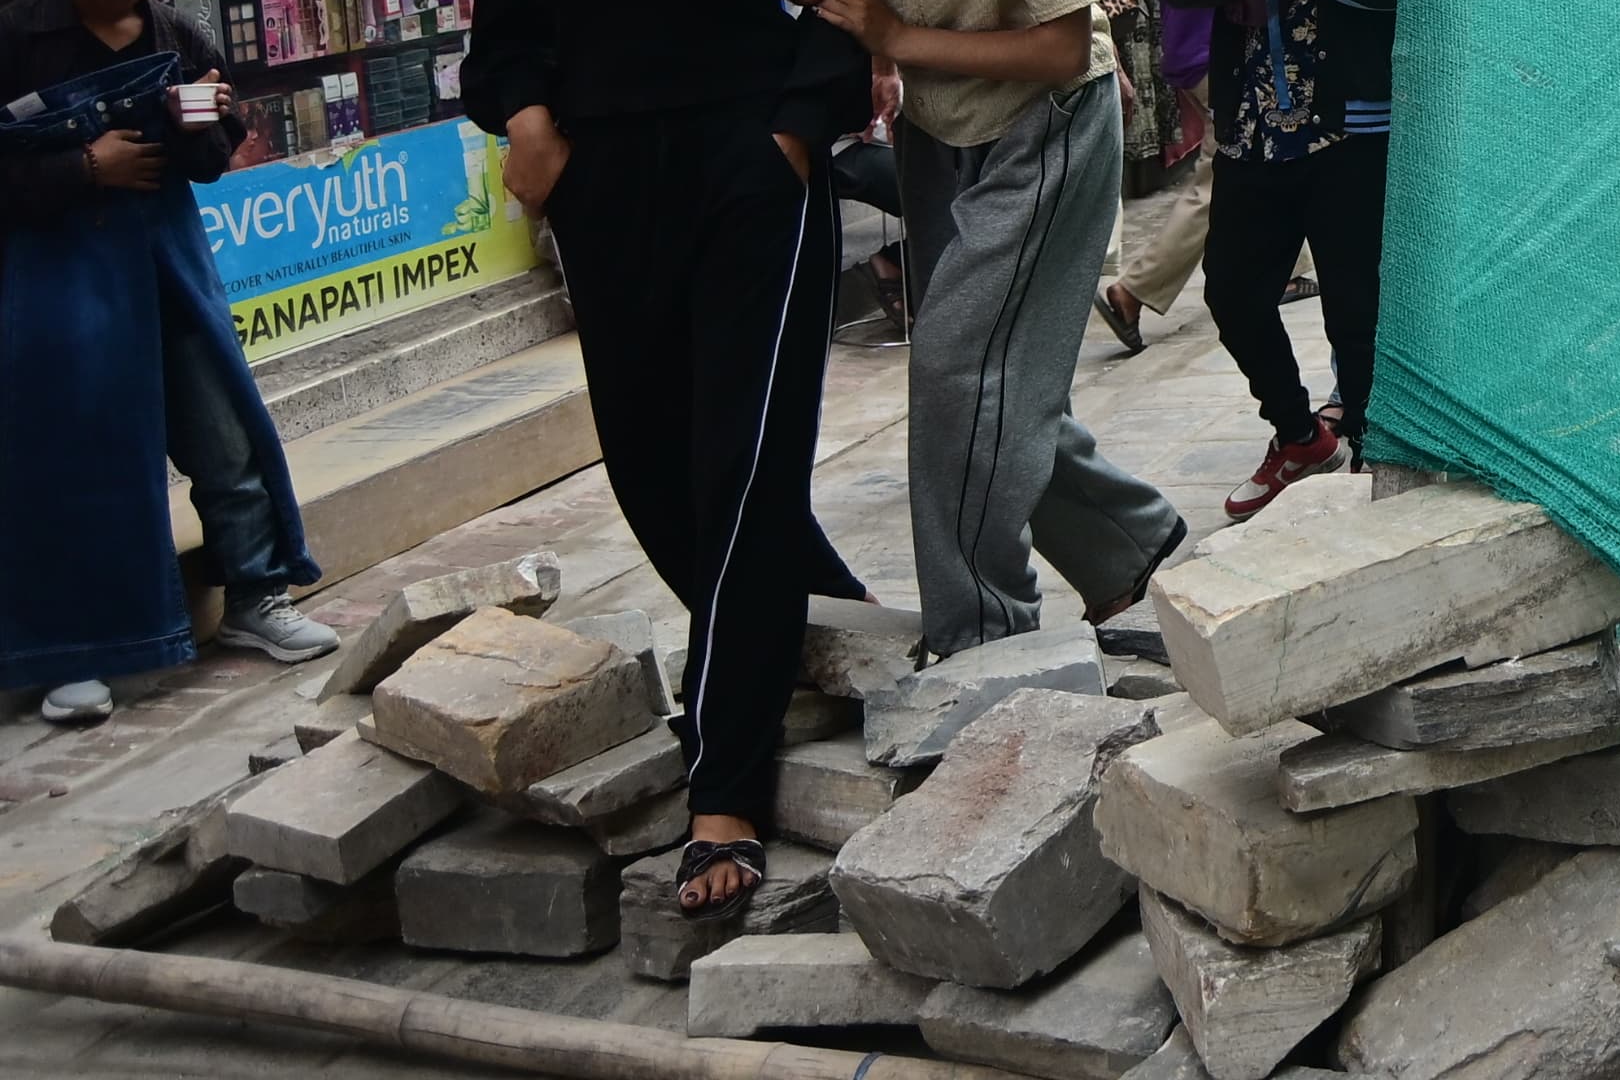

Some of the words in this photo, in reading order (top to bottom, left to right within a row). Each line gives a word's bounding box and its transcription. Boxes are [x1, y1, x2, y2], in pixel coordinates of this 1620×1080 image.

[200, 152, 408, 254] everyuth
[328, 204, 409, 244] naturals
[265, 253, 330, 282] NATURALLY
[330, 238, 386, 264] BEAUTIFUL
[388, 231, 412, 247] SKIN
[393, 242, 480, 298] IMPEX
